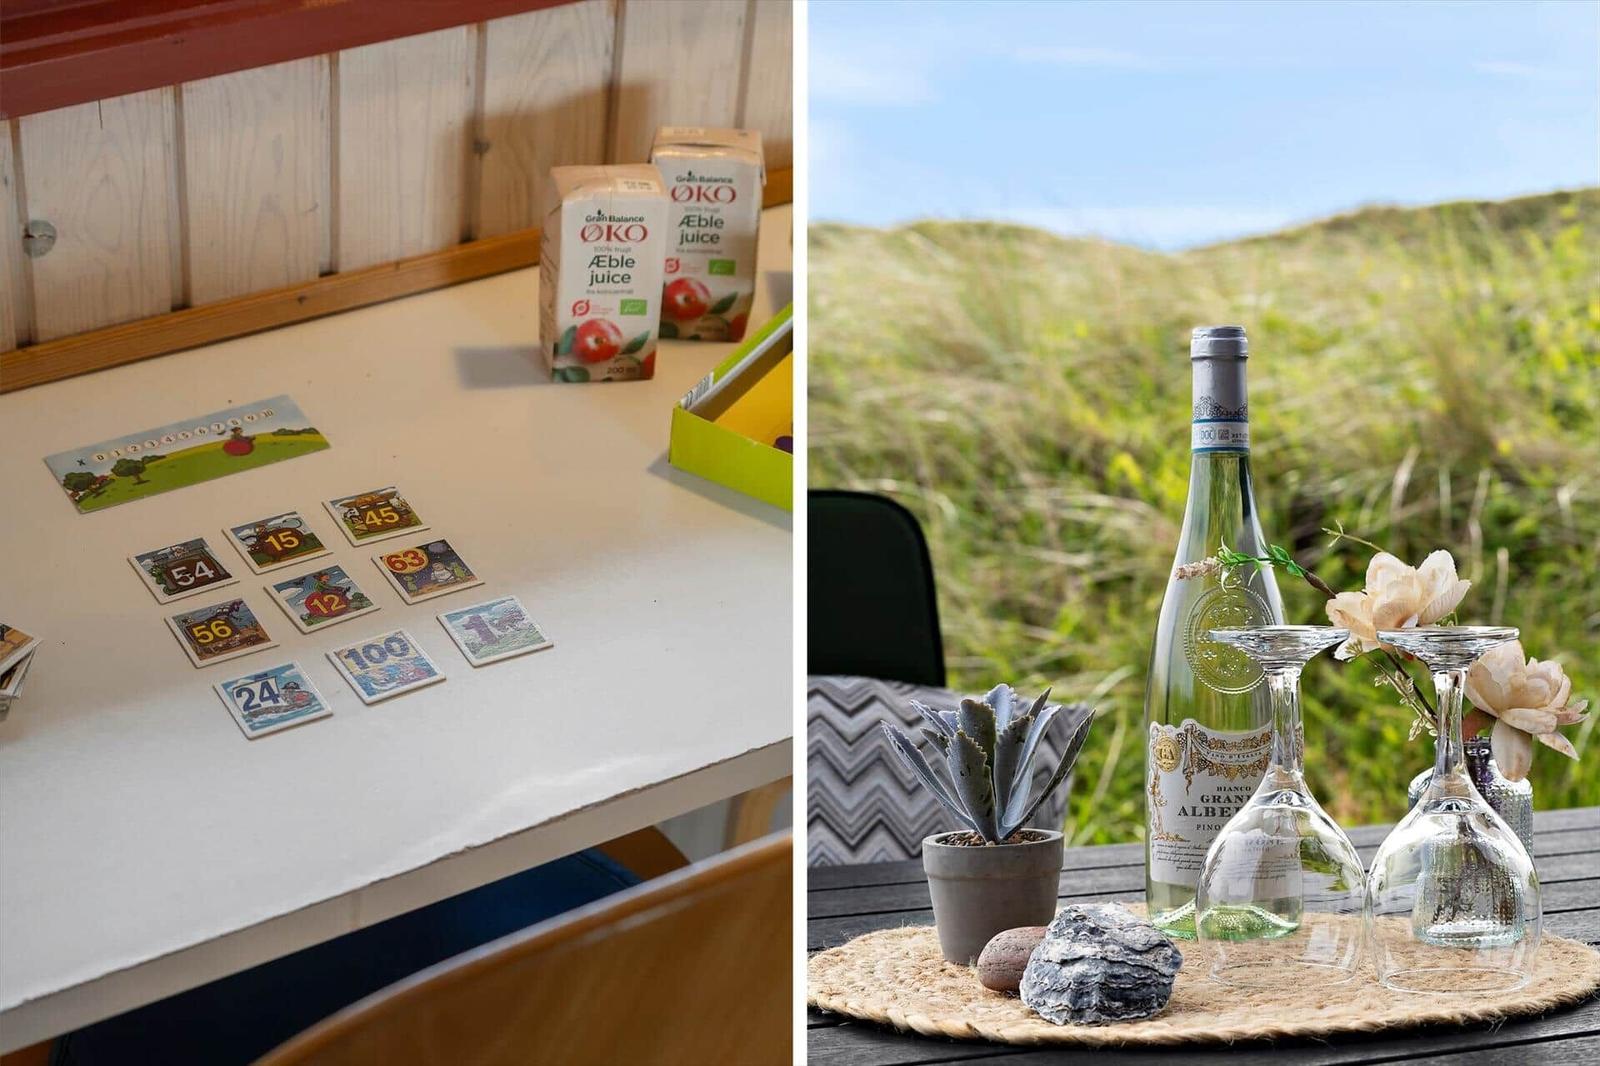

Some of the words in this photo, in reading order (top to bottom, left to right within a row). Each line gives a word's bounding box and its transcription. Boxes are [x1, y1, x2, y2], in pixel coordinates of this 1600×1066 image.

[671, 185, 737, 204] ØKO
[609, 215, 645, 223] Balance
[678, 214, 725, 229] Æble
[580, 223, 648, 242] ØKO
[679, 230, 721, 245] juice
[588, 254, 636, 269] Æble
[588, 270, 632, 287] juice
[364, 506, 400, 526] 45
[265, 530, 300, 551] 15
[386, 549, 425, 572] 63
[171, 560, 215, 586] 54
[310, 594, 347, 615] 12
[192, 620, 232, 643] 56
[462, 614, 499, 646] 1
[344, 636, 410, 670] 100
[235, 680, 281, 712] 24
